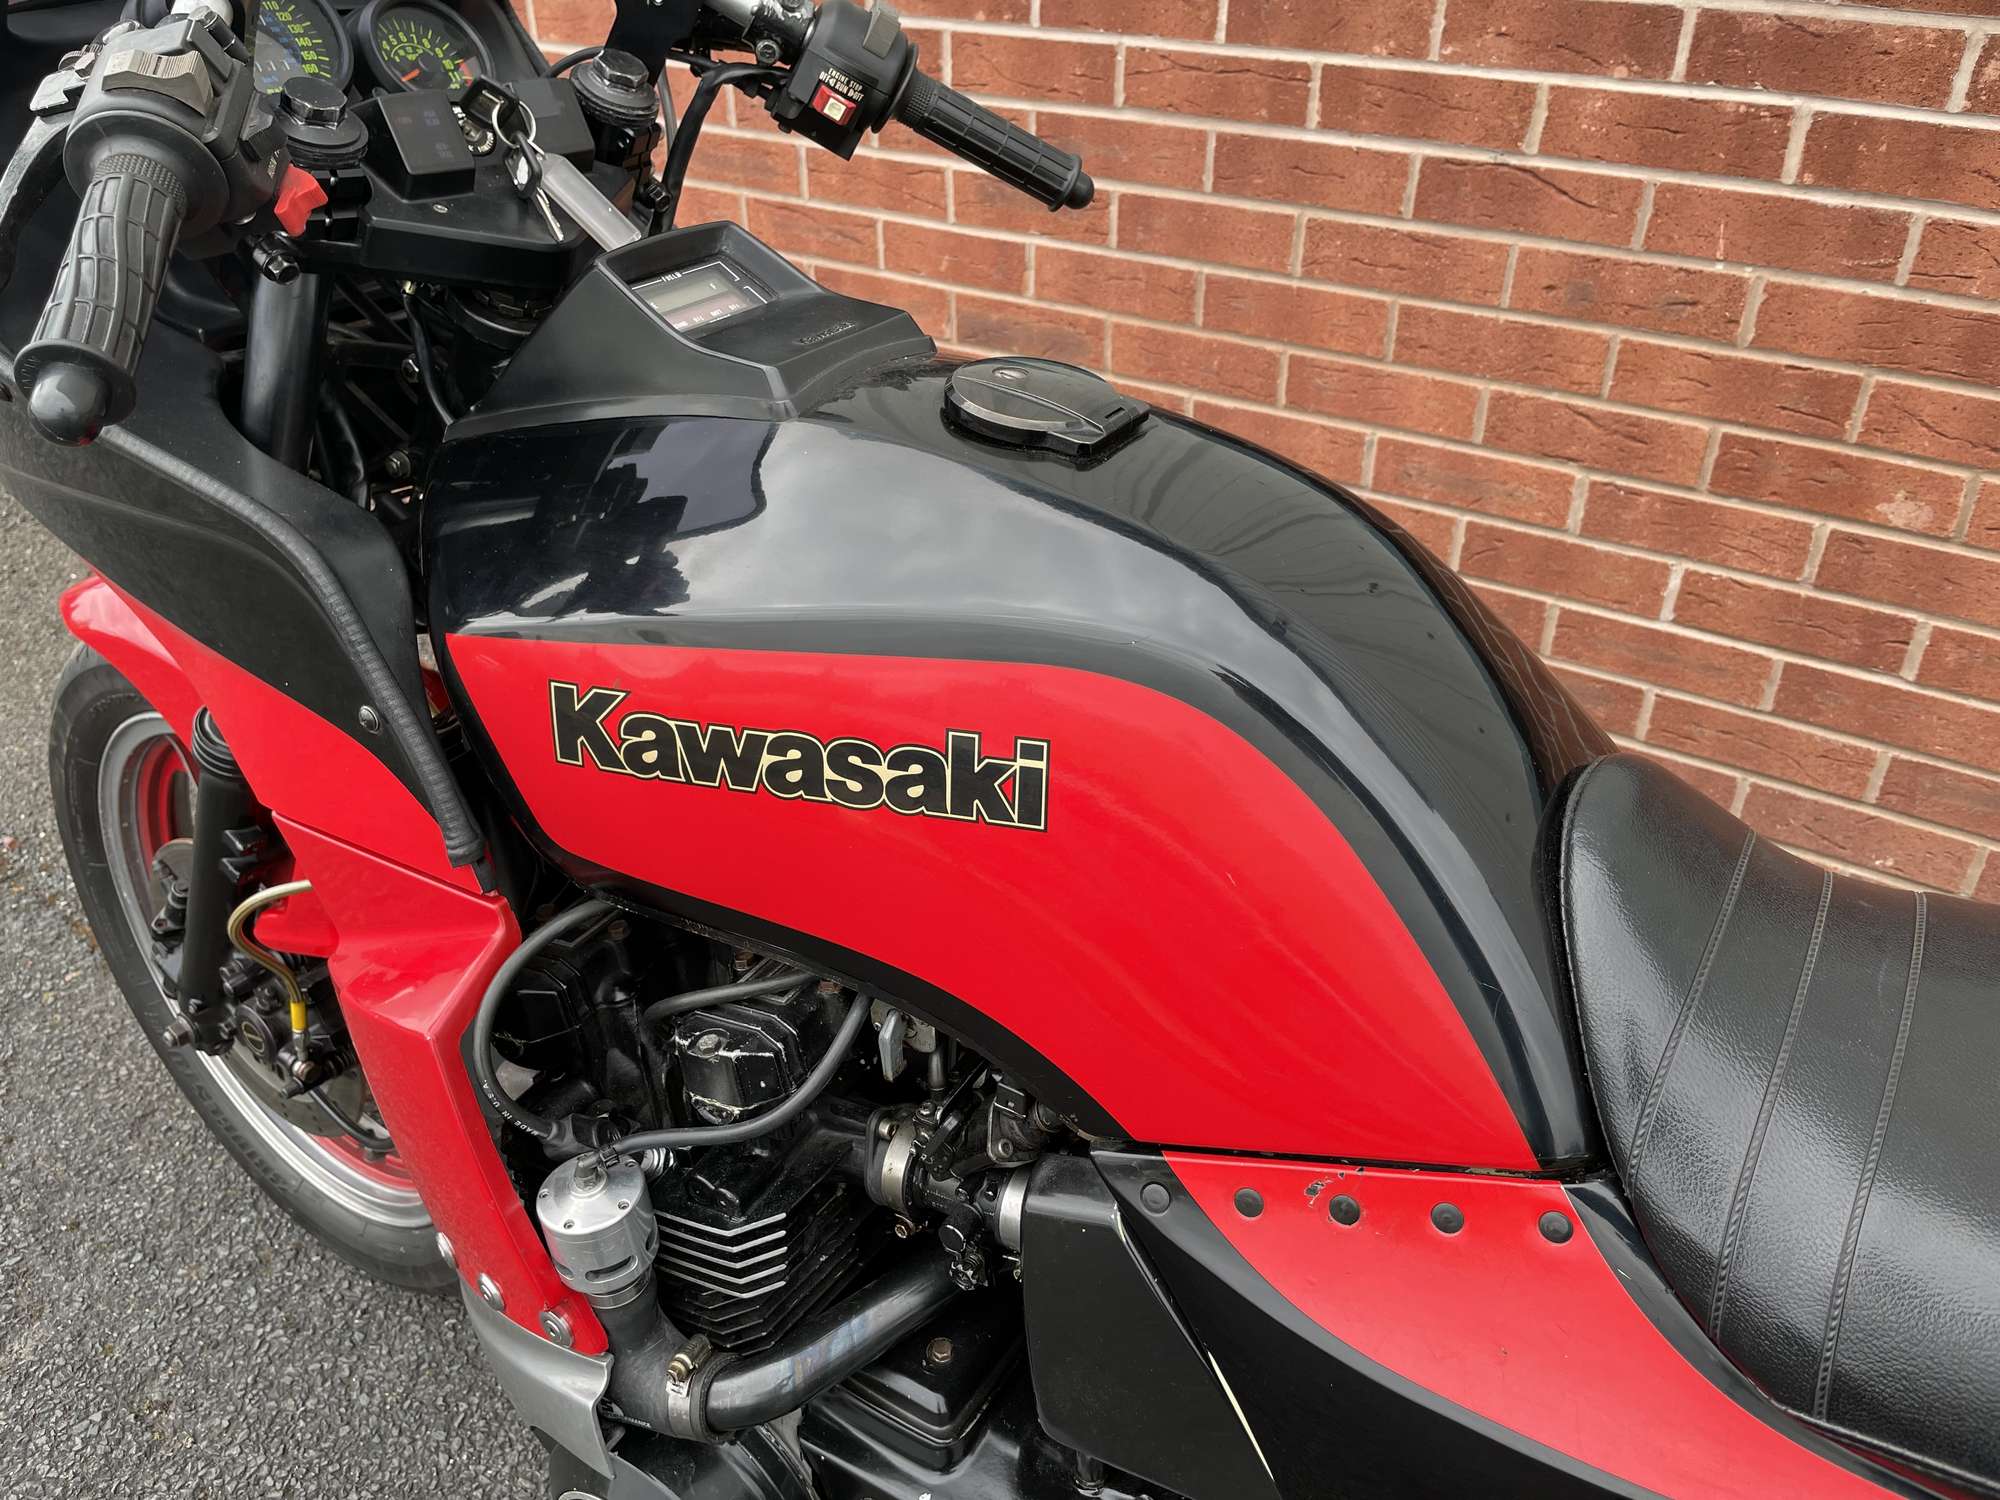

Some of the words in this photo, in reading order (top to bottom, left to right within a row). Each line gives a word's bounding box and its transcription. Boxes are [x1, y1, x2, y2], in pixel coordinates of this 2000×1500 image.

[276, 12, 292, 21] 120
[288, 24, 304, 34] 130
[295, 37, 313, 47] 140
[301, 50, 318, 60] 150
[302, 63, 319, 74] 160
[819, 71, 831, 83] OFF
[835, 81, 849, 94] RUN
[828, 67, 849, 85] ENGINE
[849, 80, 863, 92] STOP
[548, 679, 1050, 832] Kawasaki
